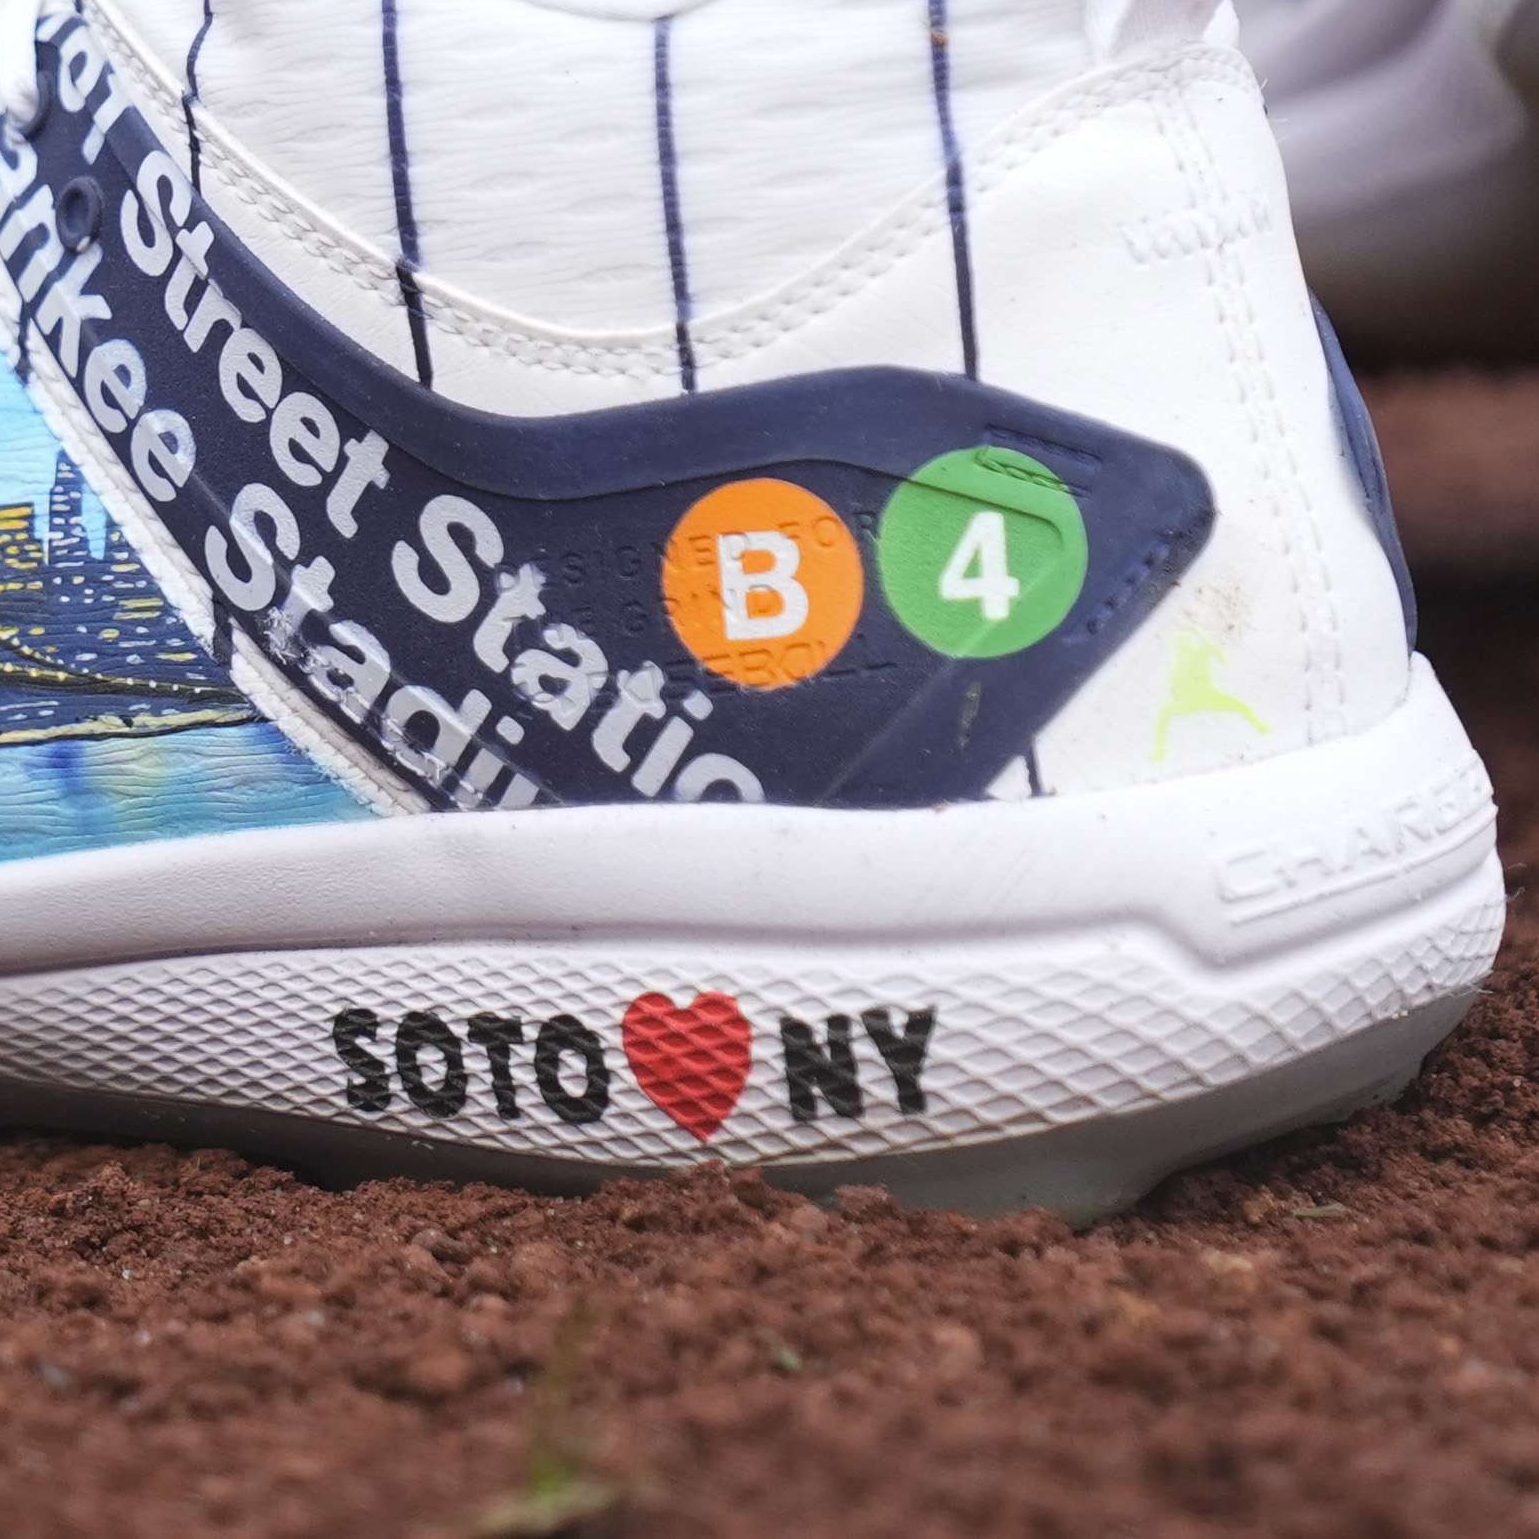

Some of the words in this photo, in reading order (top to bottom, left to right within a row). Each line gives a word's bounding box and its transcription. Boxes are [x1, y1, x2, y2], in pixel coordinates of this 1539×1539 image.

[119, 149, 391, 539] Street
[716, 529, 810, 641] B
[939, 510, 1021, 621] 4
[204, 482, 540, 811] Stadi
[332, 1007, 611, 1125] SOTO
[779, 1004, 937, 1123] NY
